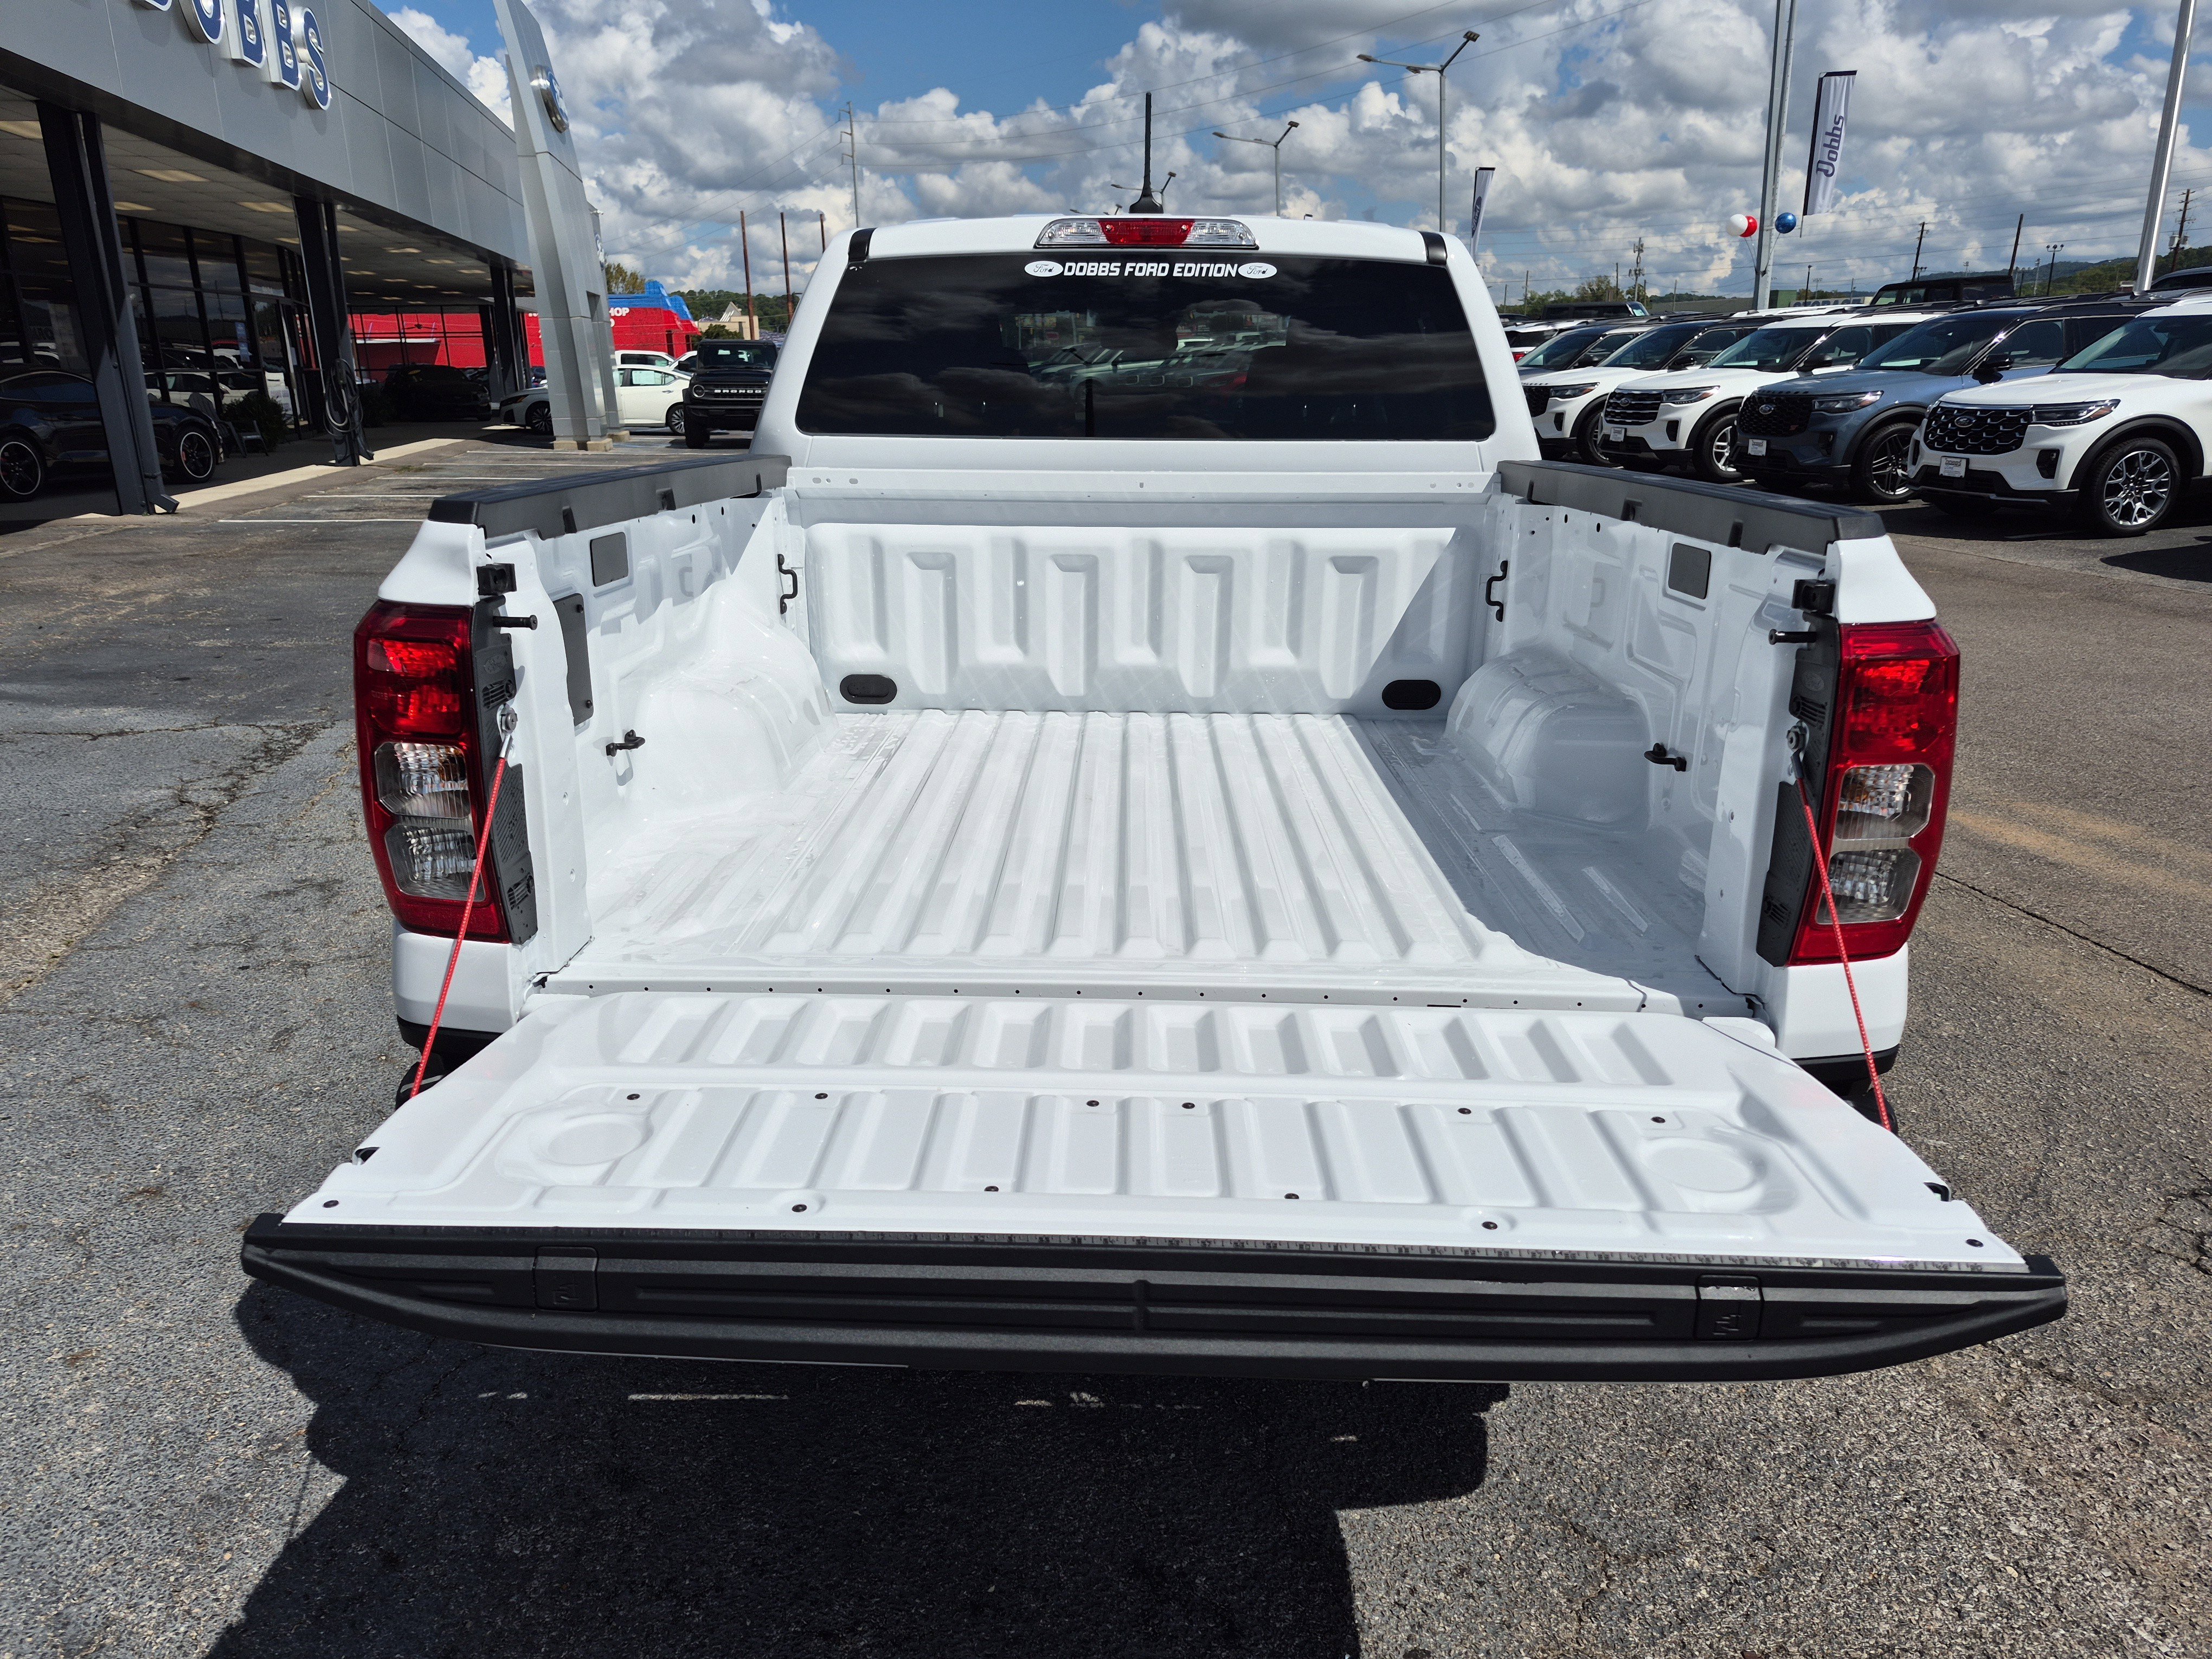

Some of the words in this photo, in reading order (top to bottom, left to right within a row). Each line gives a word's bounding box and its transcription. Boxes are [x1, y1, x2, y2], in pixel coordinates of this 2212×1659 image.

[140, 0, 331, 110] BBS
[1816, 114, 1844, 178] Dobbs
[1033, 263, 1054, 273] Ford
[1063, 262, 1121, 276] DOBBS
[1124, 263, 1169, 276] FORD
[1173, 263, 1238, 277] EDITION
[1247, 265, 1268, 274] Ford
